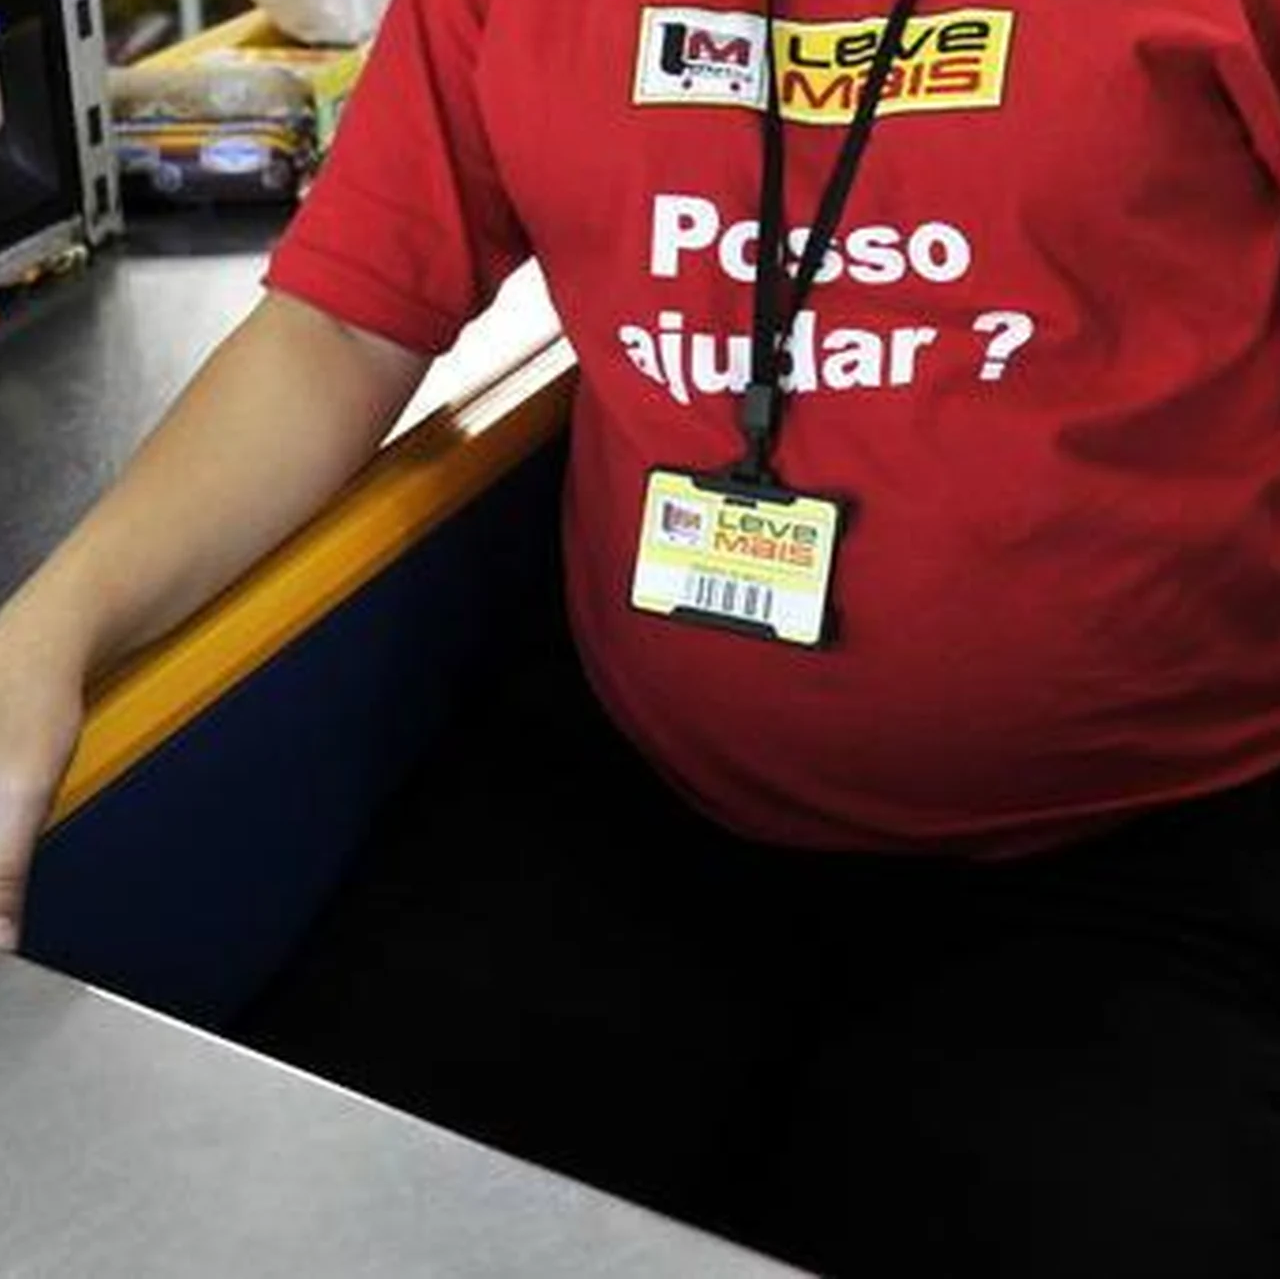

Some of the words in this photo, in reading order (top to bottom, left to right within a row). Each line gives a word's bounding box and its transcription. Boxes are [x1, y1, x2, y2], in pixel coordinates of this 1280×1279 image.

[650, 193, 972, 283] Posso
[617, 309, 937, 406] ajudar
[972, 311, 1035, 381] ?
